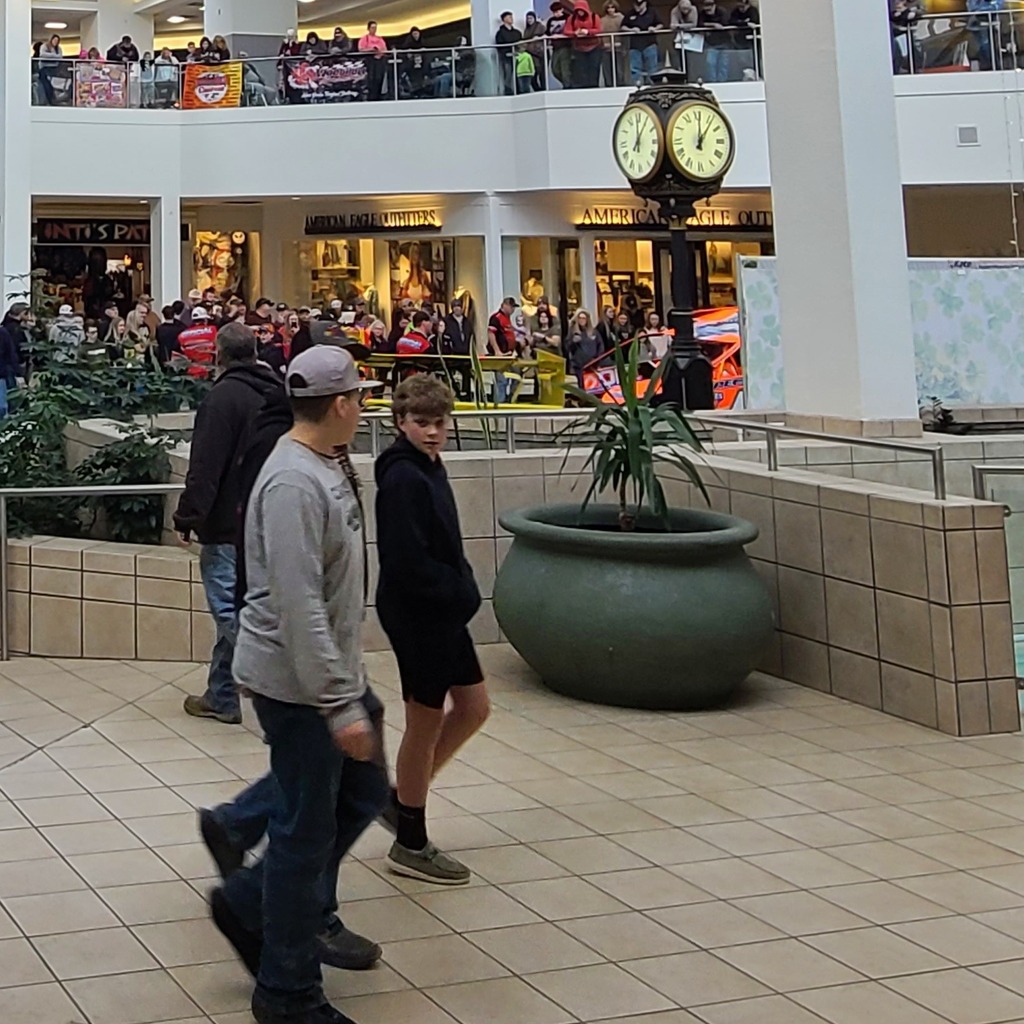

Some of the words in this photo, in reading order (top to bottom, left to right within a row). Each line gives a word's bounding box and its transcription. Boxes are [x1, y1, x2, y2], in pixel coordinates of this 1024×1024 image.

[305, 214, 346, 228] AMERICAN
[350, 212, 377, 227] EAGLE
[379, 210, 436, 227] OUTFITTERS
[582, 208, 661, 225] AMERICA
[690, 210, 731, 226] AGLE
[738, 210, 773, 226] OUT
